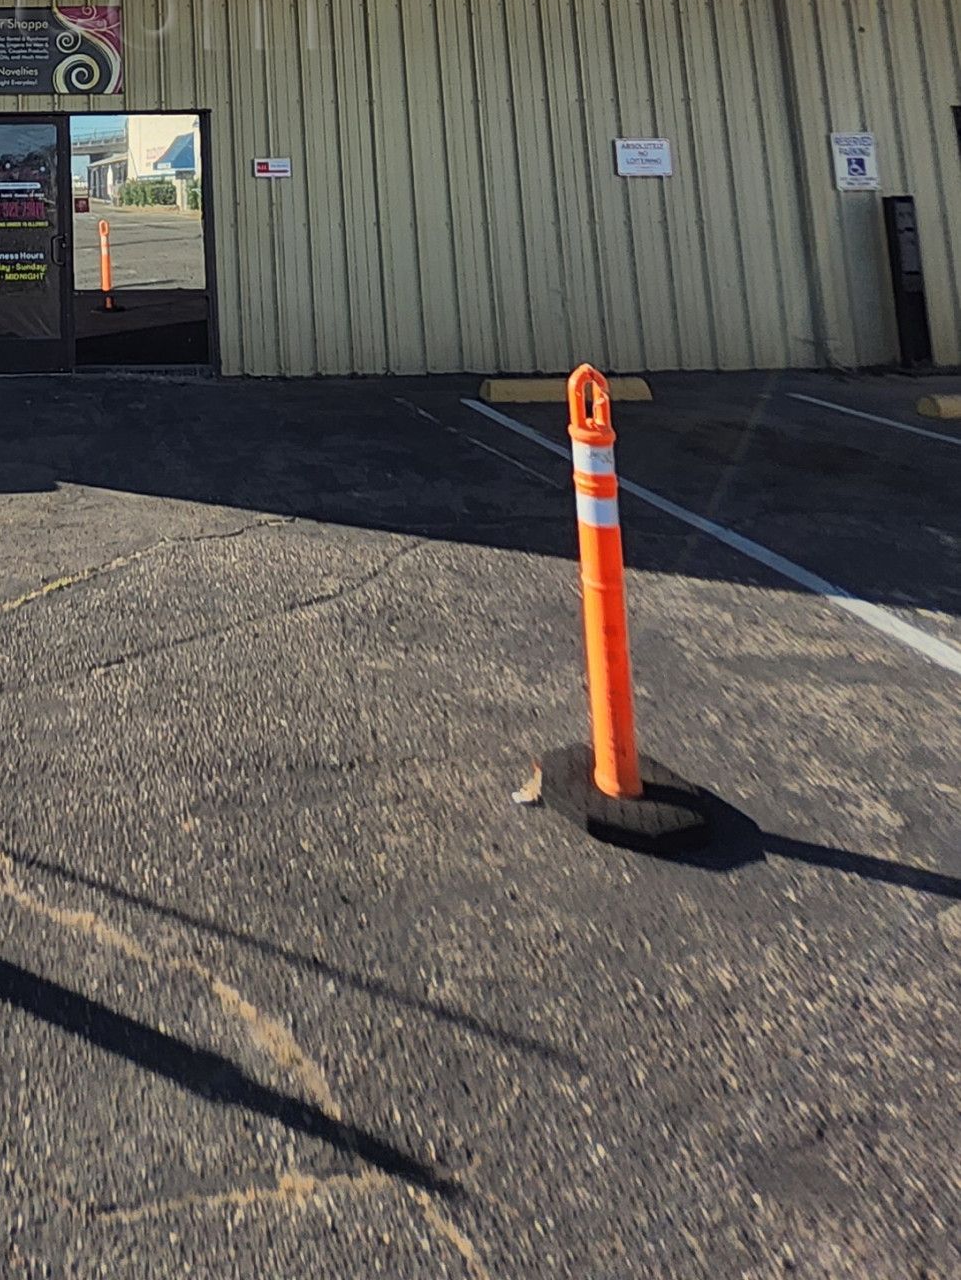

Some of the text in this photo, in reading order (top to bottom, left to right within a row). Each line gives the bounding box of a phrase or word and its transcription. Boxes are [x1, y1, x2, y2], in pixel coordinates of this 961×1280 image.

[7, 18, 49, 32] Shoppe
[19, 251, 45, 260] Hours
[4, 272, 45, 281] MIDNIGHT
